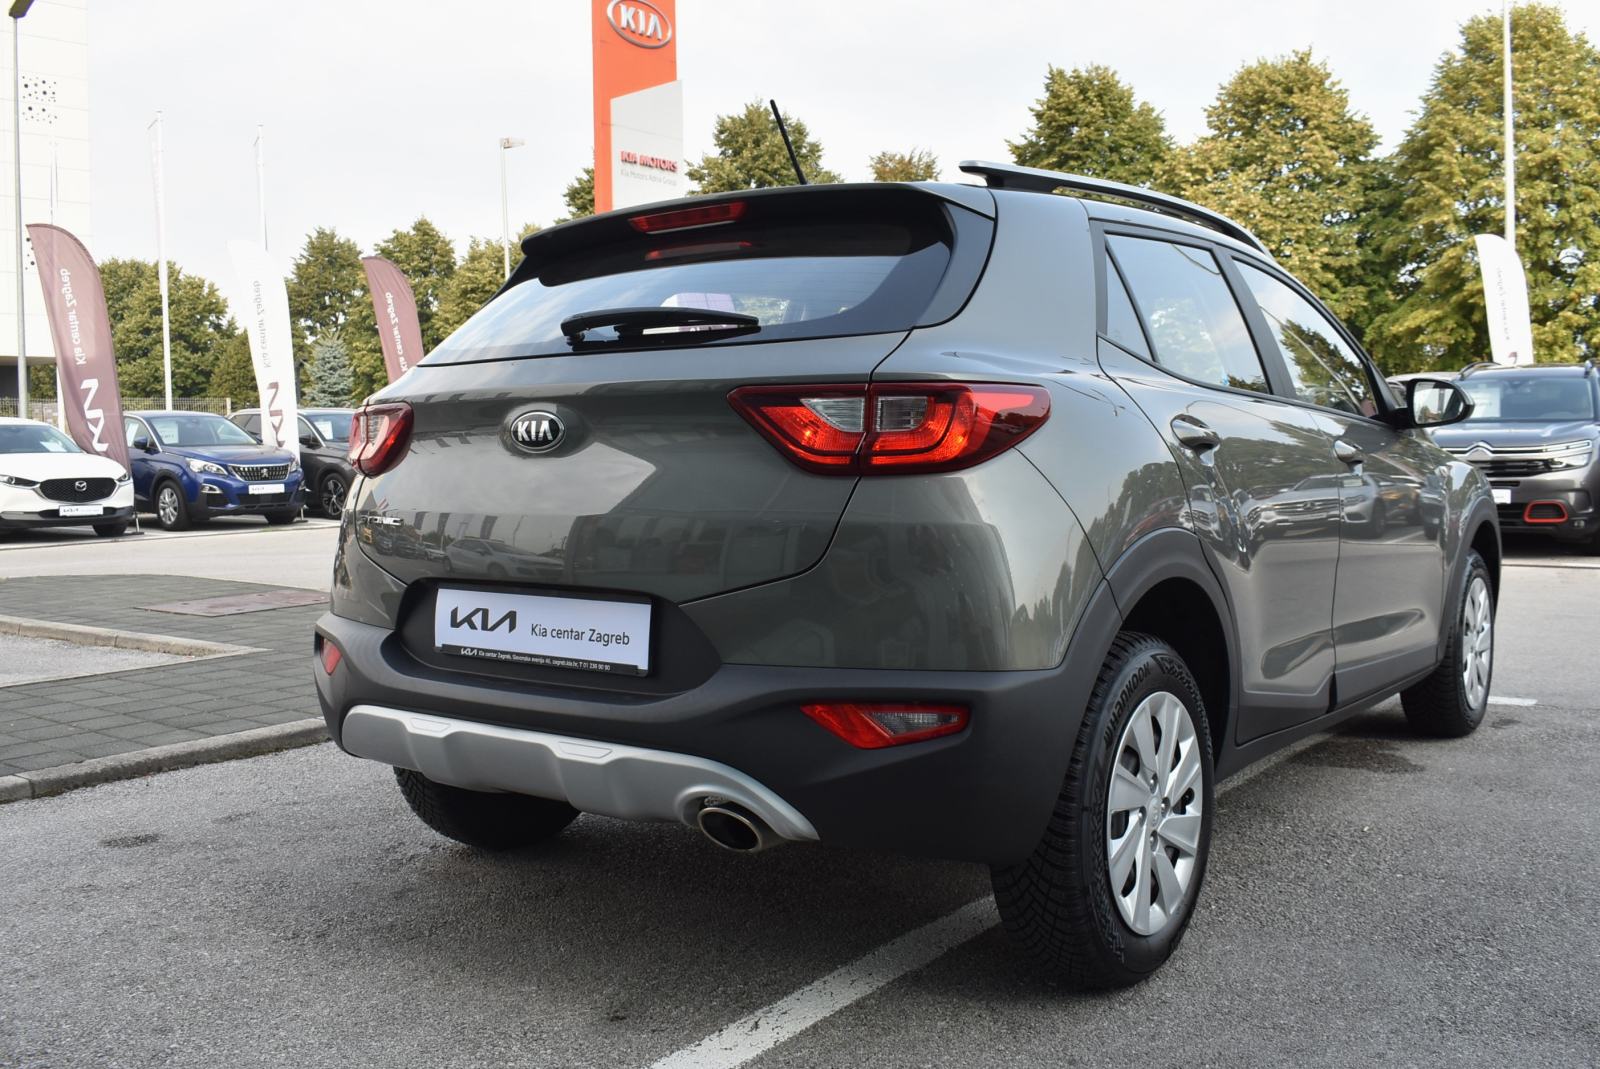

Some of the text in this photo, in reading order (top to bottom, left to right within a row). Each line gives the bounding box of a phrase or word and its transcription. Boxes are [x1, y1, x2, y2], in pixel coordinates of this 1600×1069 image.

[619, 3, 663, 40] KIA
[620, 150, 678, 172] KIA MOTORS
[517, 420, 553, 441] KIA
[450, 606, 517, 634] KIA
[531, 624, 630, 646] Kia centar Zagreb
